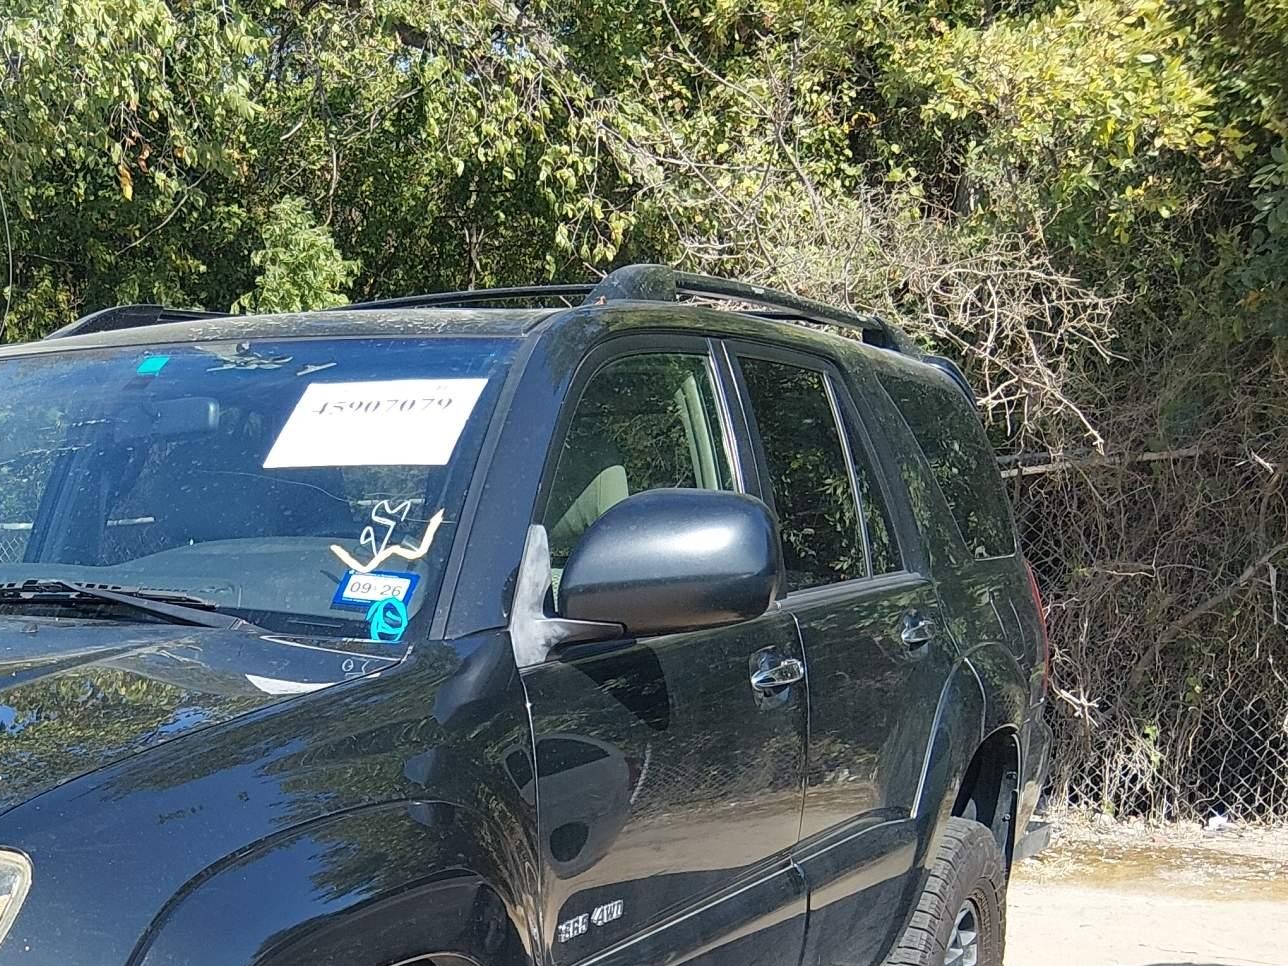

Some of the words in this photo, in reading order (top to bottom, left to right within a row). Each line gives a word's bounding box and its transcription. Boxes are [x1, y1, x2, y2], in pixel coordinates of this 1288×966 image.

[312, 398, 453, 415] 45907079
[350, 582, 372, 594] 09
[379, 585, 402, 597] 26
[591, 899, 624, 926] 4WD
